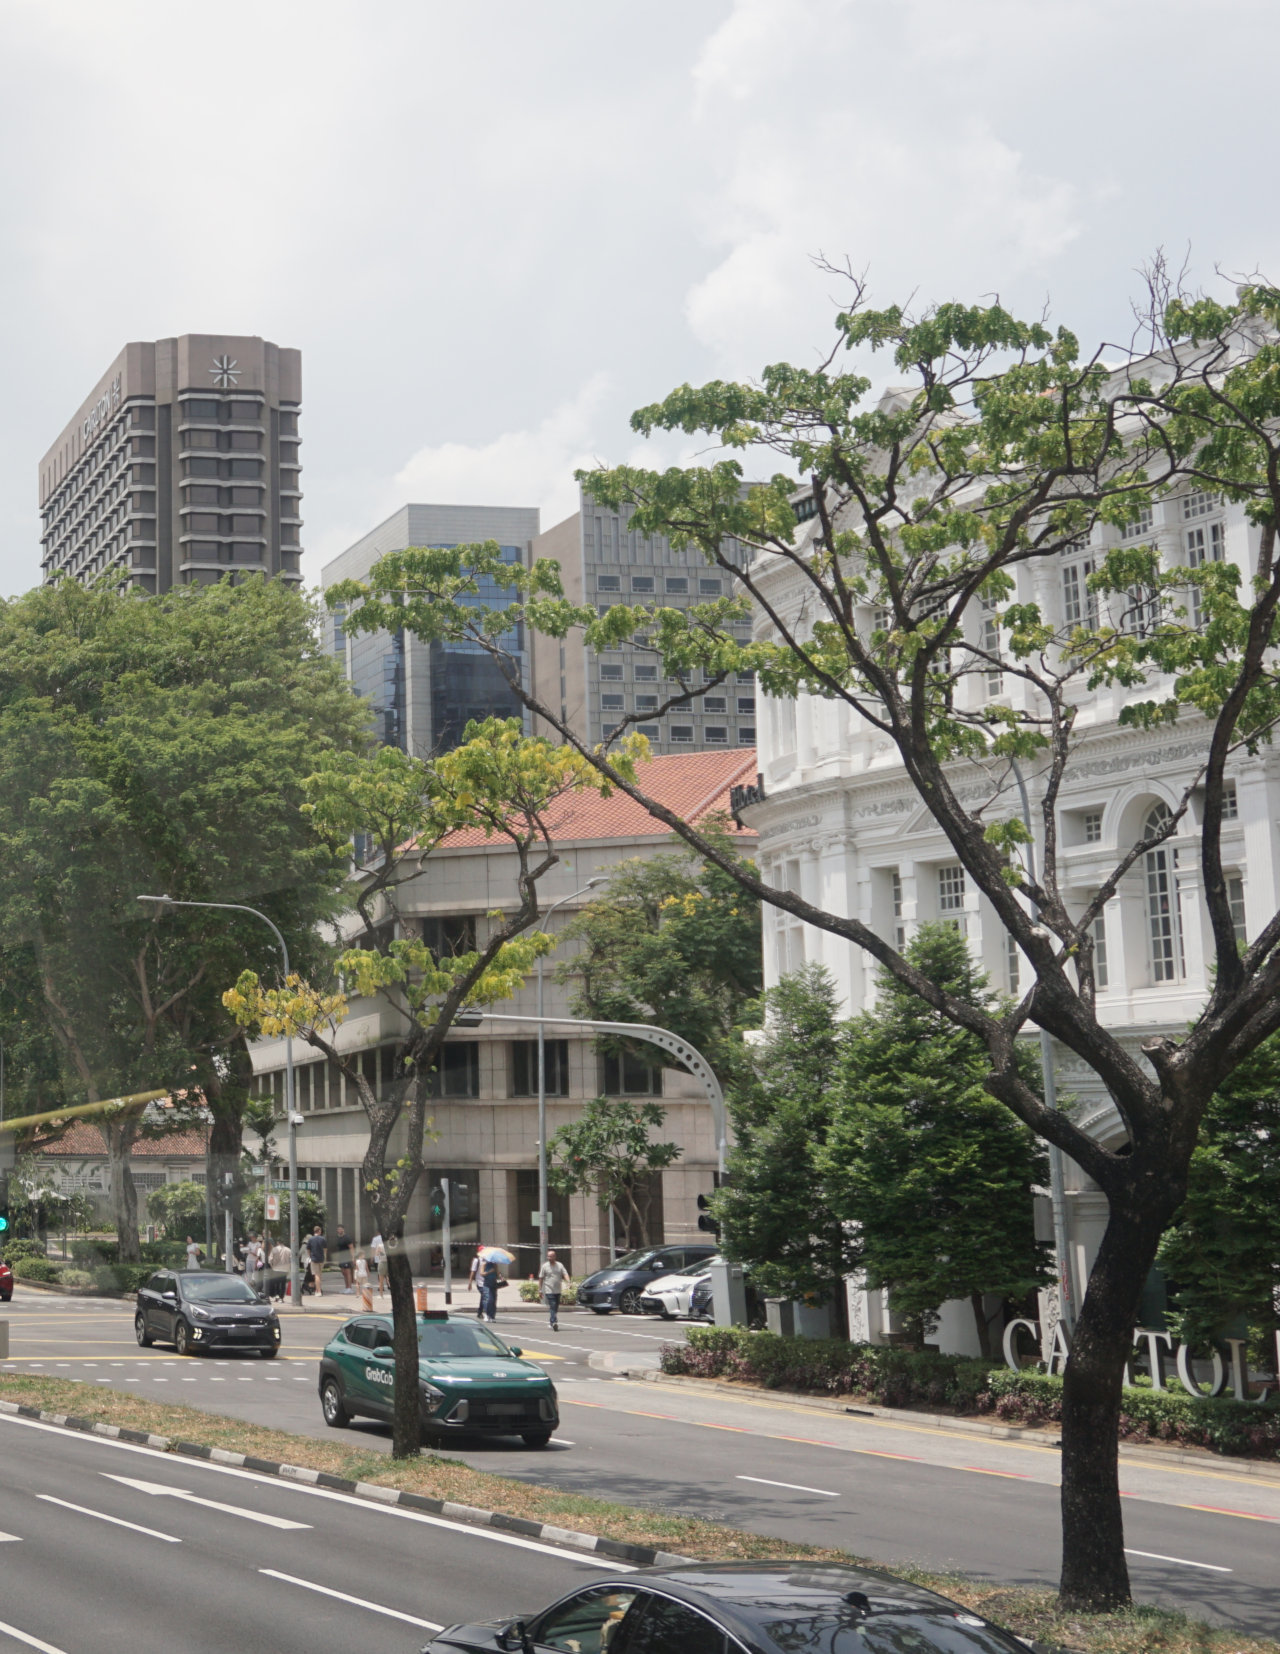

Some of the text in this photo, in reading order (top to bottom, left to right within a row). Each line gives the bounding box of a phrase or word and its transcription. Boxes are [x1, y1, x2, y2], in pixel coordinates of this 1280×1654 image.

[83, 391, 110, 440] CARLTON
[307, 1182, 316, 1190] RD
[365, 1366, 394, 1386] GrabCab
[1002, 1318, 1270, 1403] CATOL
